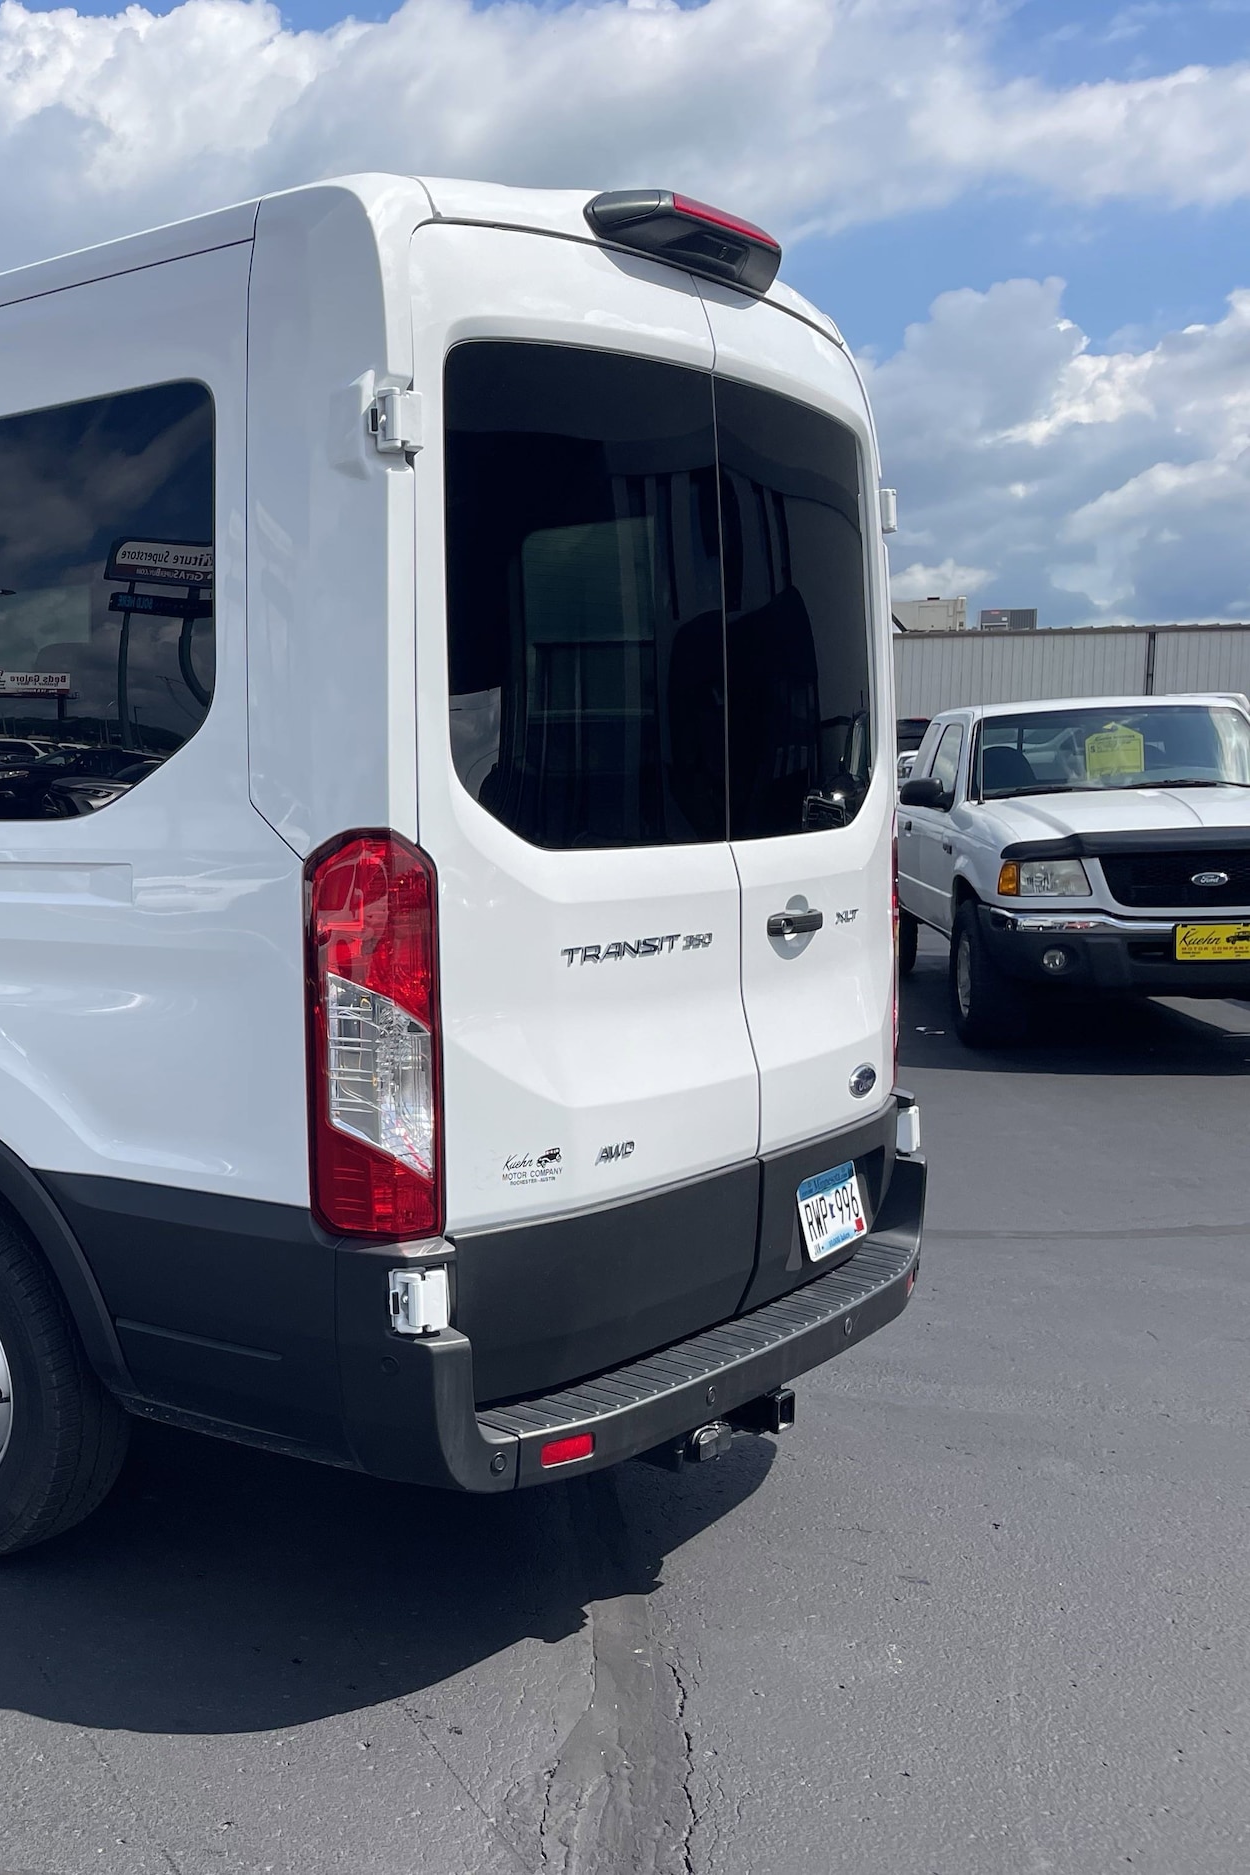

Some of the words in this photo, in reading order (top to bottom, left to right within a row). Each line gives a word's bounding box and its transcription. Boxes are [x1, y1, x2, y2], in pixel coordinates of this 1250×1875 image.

[835, 909, 859, 925] XLT
[1179, 930, 1221, 947] Kuehn
[561, 934, 681, 967] TRANSIT
[682, 932, 713, 951] 350
[502, 1152, 534, 1171] Kuehn
[594, 1140, 635, 1166] AWD
[502, 1171, 527, 1181] MOTOR
[530, 1167, 563, 1178] COMPANY
[804, 1196, 828, 1242] RWP
[834, 1182, 859, 1224] 996
